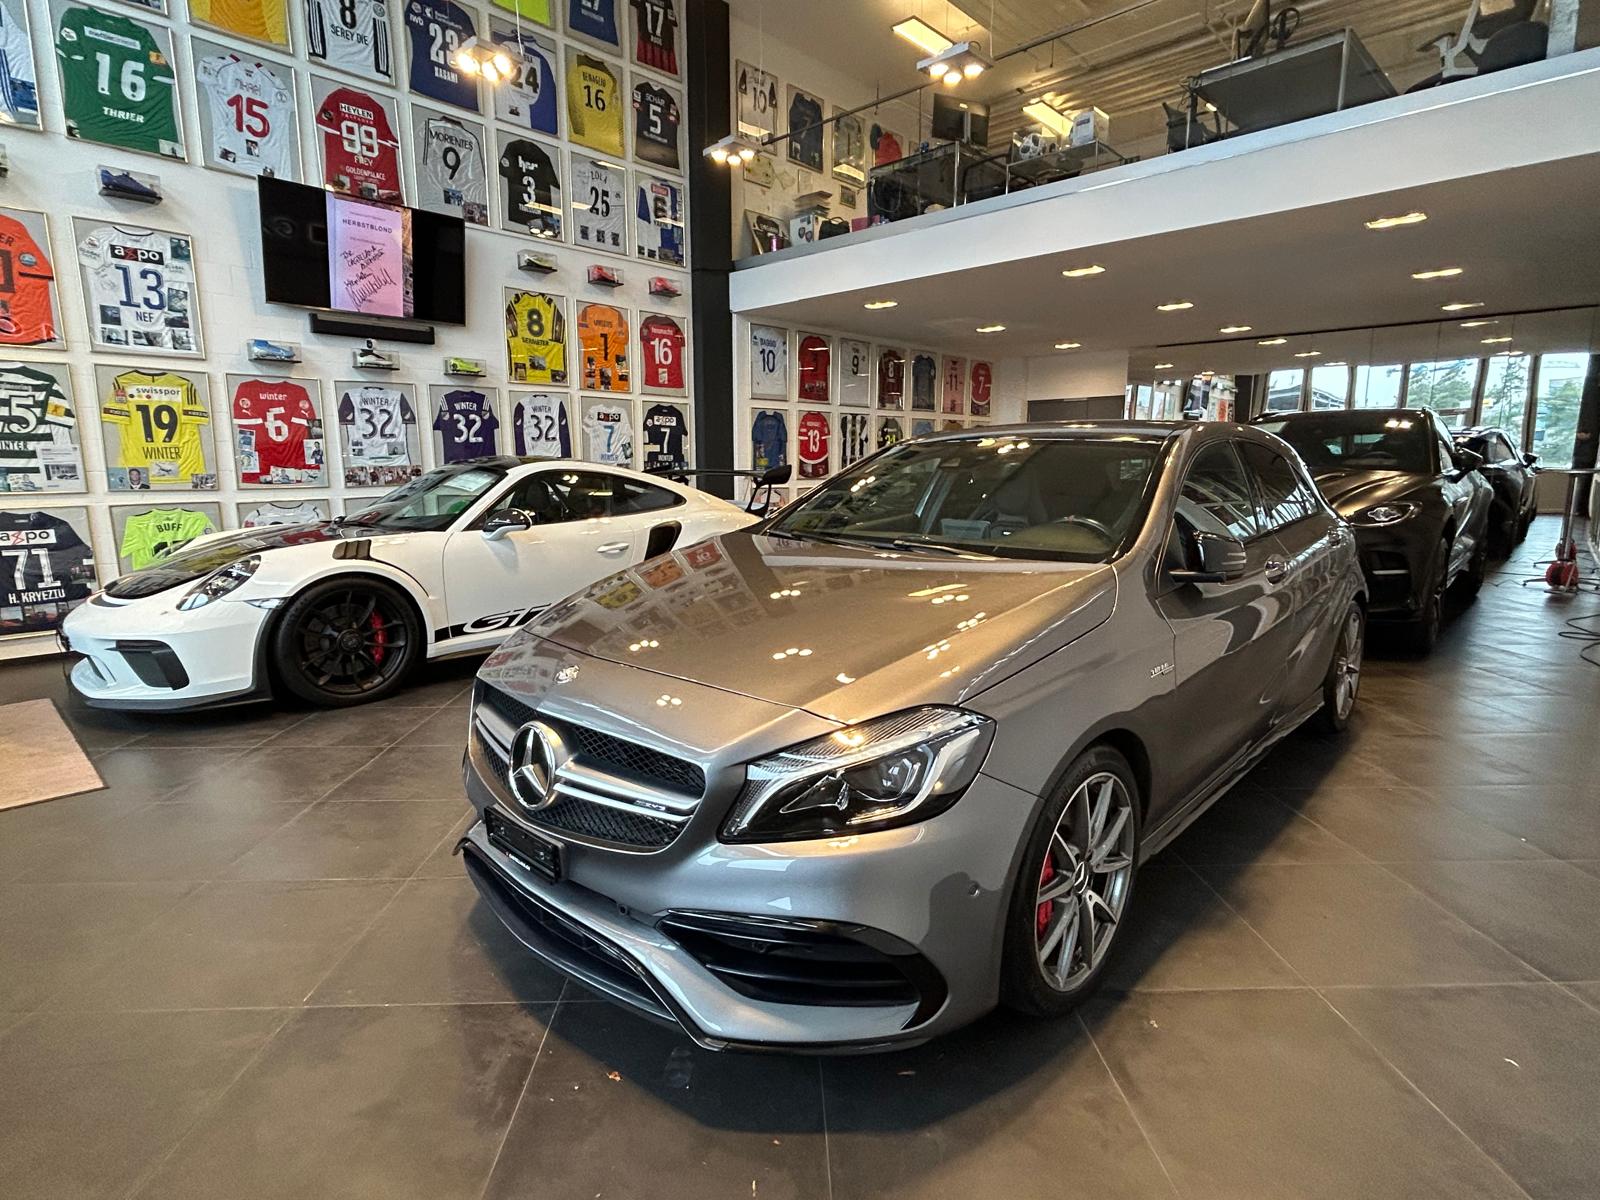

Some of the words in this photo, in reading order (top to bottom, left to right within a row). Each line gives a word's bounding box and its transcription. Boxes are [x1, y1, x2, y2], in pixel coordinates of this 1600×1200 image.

[340, 0, 356, 29] 8
[645, 2, 664, 36] 17
[330, 24, 355, 42] SEREY
[356, 34, 369, 46] DIE
[96, 52, 146, 101] 16
[434, 66, 458, 83] KASAMI
[340, 104, 373, 119] HEYLEN
[583, 85, 606, 112] 16
[752, 87, 767, 113] 10
[102, 106, 144, 123] THRIER
[227, 94, 270, 138] 15
[650, 103, 661, 135] 5
[341, 121, 379, 158] 99
[429, 130, 474, 150] MORIENTES
[354, 155, 373, 166] FREY
[442, 147, 461, 180] 9
[522, 175, 536, 205] 3
[590, 187, 610, 217] 25
[342, 219, 393, 233] HERBSTBLOND
[115, 264, 166, 310] 13
[136, 310, 154, 323] NEF
[527, 308, 544, 337] 8
[600, 333, 608, 361] 1
[650, 337, 672, 366] 16
[760, 349, 776, 373] 10
[852, 355, 859, 376] 9
[136, 386, 181, 395] swisspor
[259, 392, 288, 401] winter
[362, 397, 390, 406] WINTER
[454, 402, 477, 412] WINTER
[531, 406, 552, 414] WINTER
[136, 404, 178, 443] 19
[265, 406, 289, 442] 6
[360, 408, 396, 439] 32
[453, 413, 484, 443] 32
[530, 415, 557, 443] 32
[0, 440, 28, 451] INTER
[603, 425, 614, 453] 7
[660, 427, 671, 453] 7
[808, 429, 820, 453] 13
[143, 446, 182, 460] WINTER
[156, 522, 183, 533] BUFF
[1, 548, 62, 590] 71
[8, 593, 20, 604] H.
[22, 588, 66, 603] KRYEZIU
